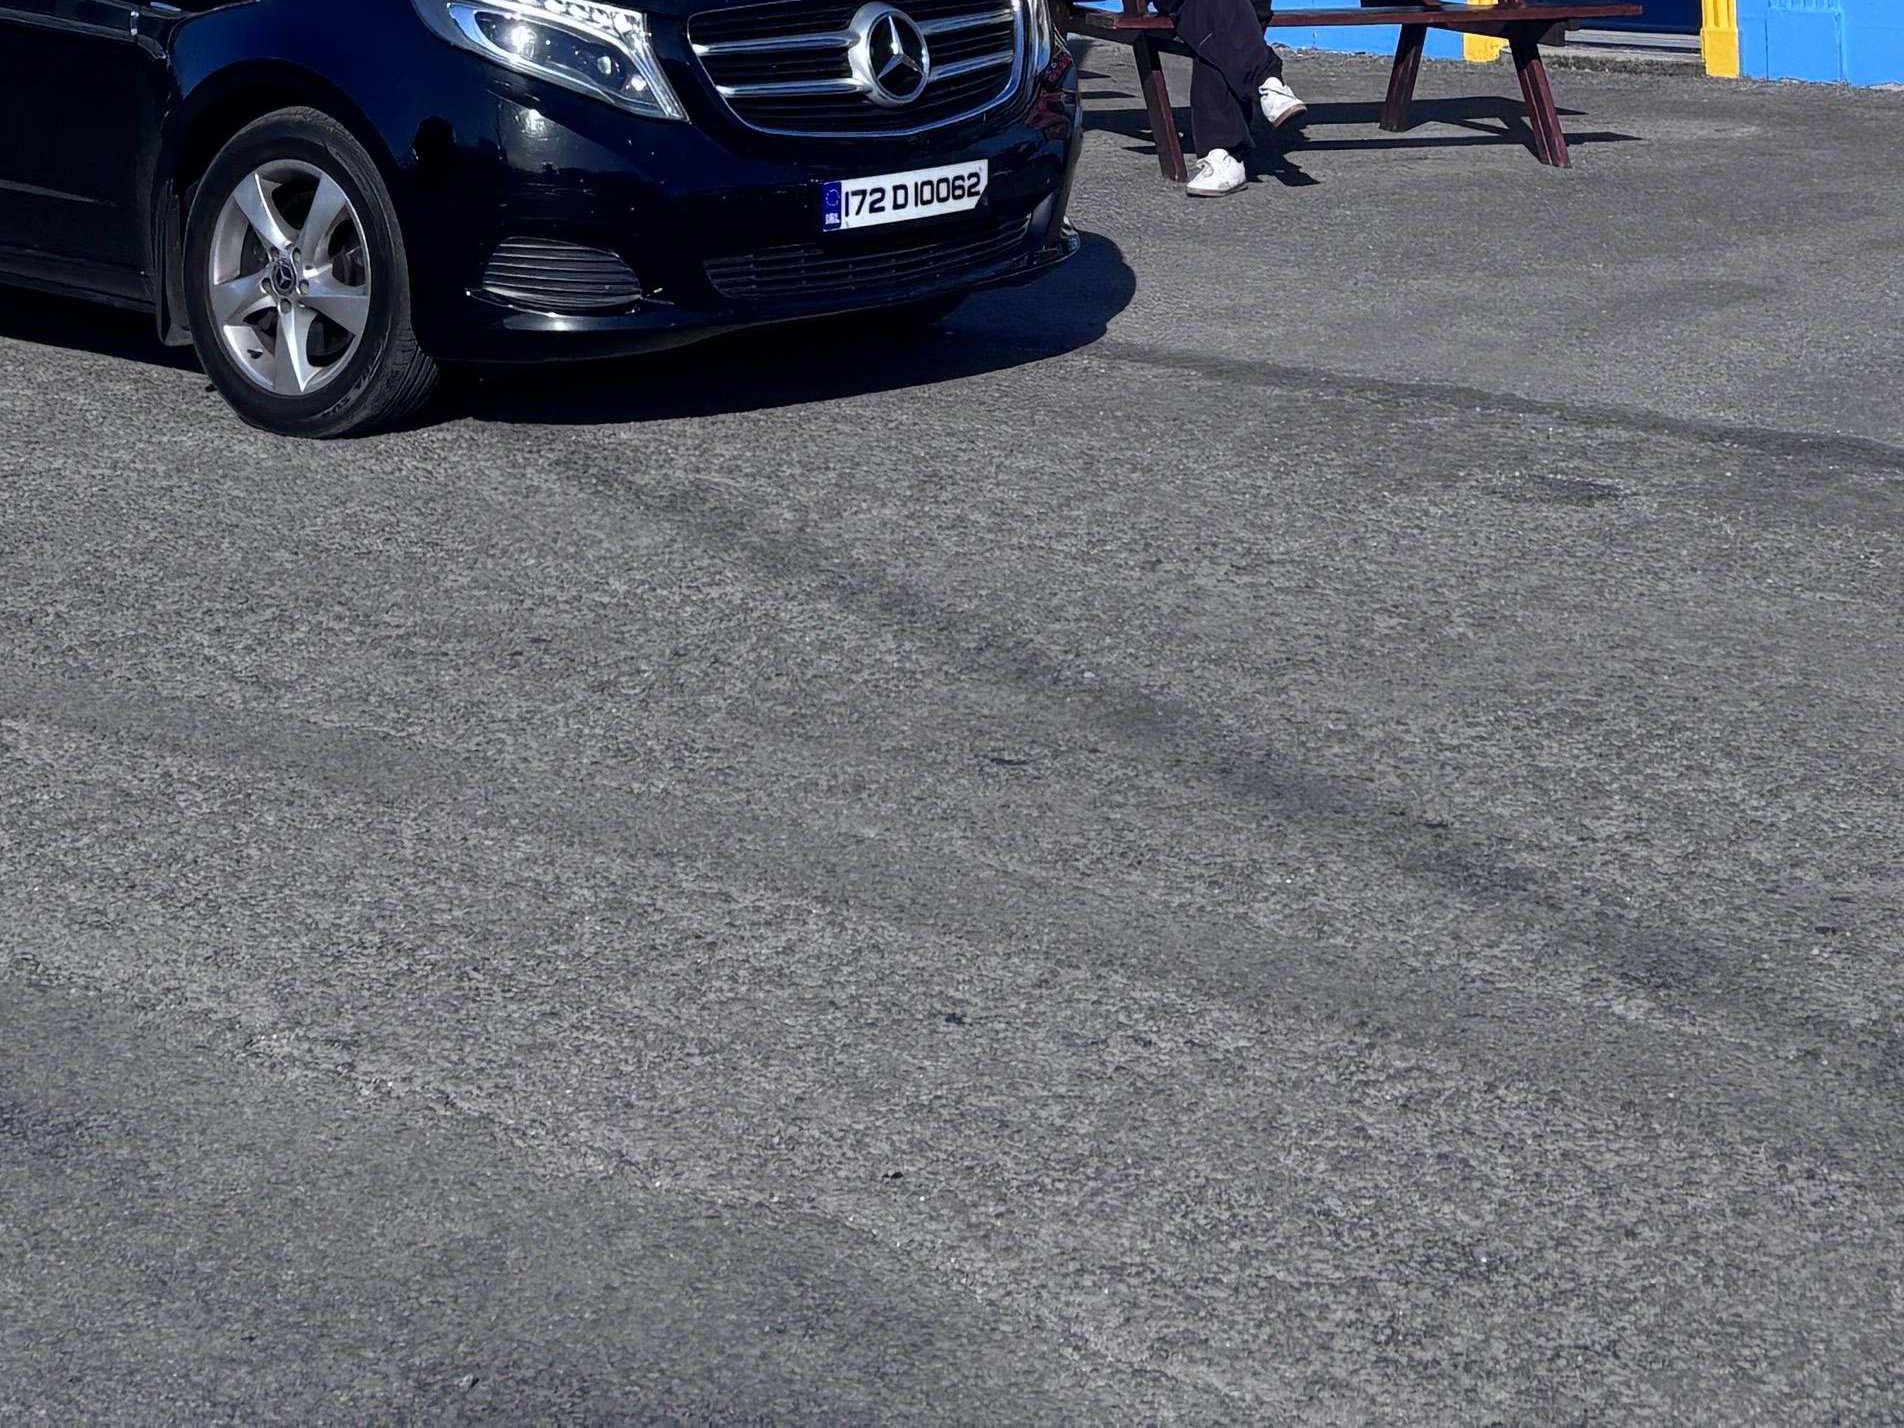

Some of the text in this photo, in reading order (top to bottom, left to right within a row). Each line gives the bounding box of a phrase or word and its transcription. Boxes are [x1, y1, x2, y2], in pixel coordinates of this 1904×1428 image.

[844, 171, 981, 218] 172 D 10062
